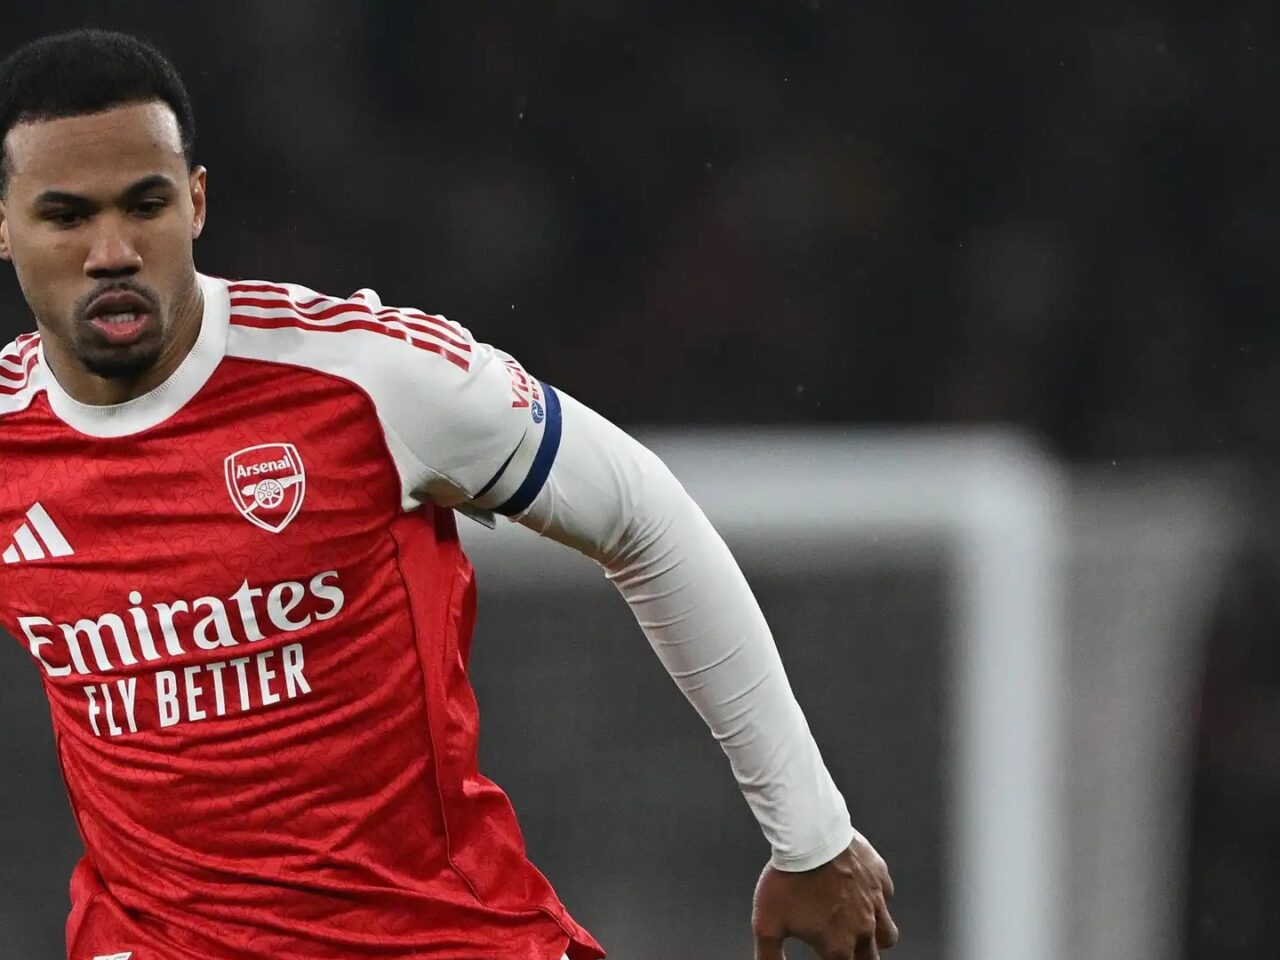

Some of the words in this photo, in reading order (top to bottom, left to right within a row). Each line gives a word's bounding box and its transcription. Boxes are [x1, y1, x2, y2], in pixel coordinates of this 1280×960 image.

[236, 454, 293, 479] Arsenal
[17, 570, 345, 677] Emirates
[82, 678, 139, 737] FLY
[155, 643, 312, 728] BETTER
